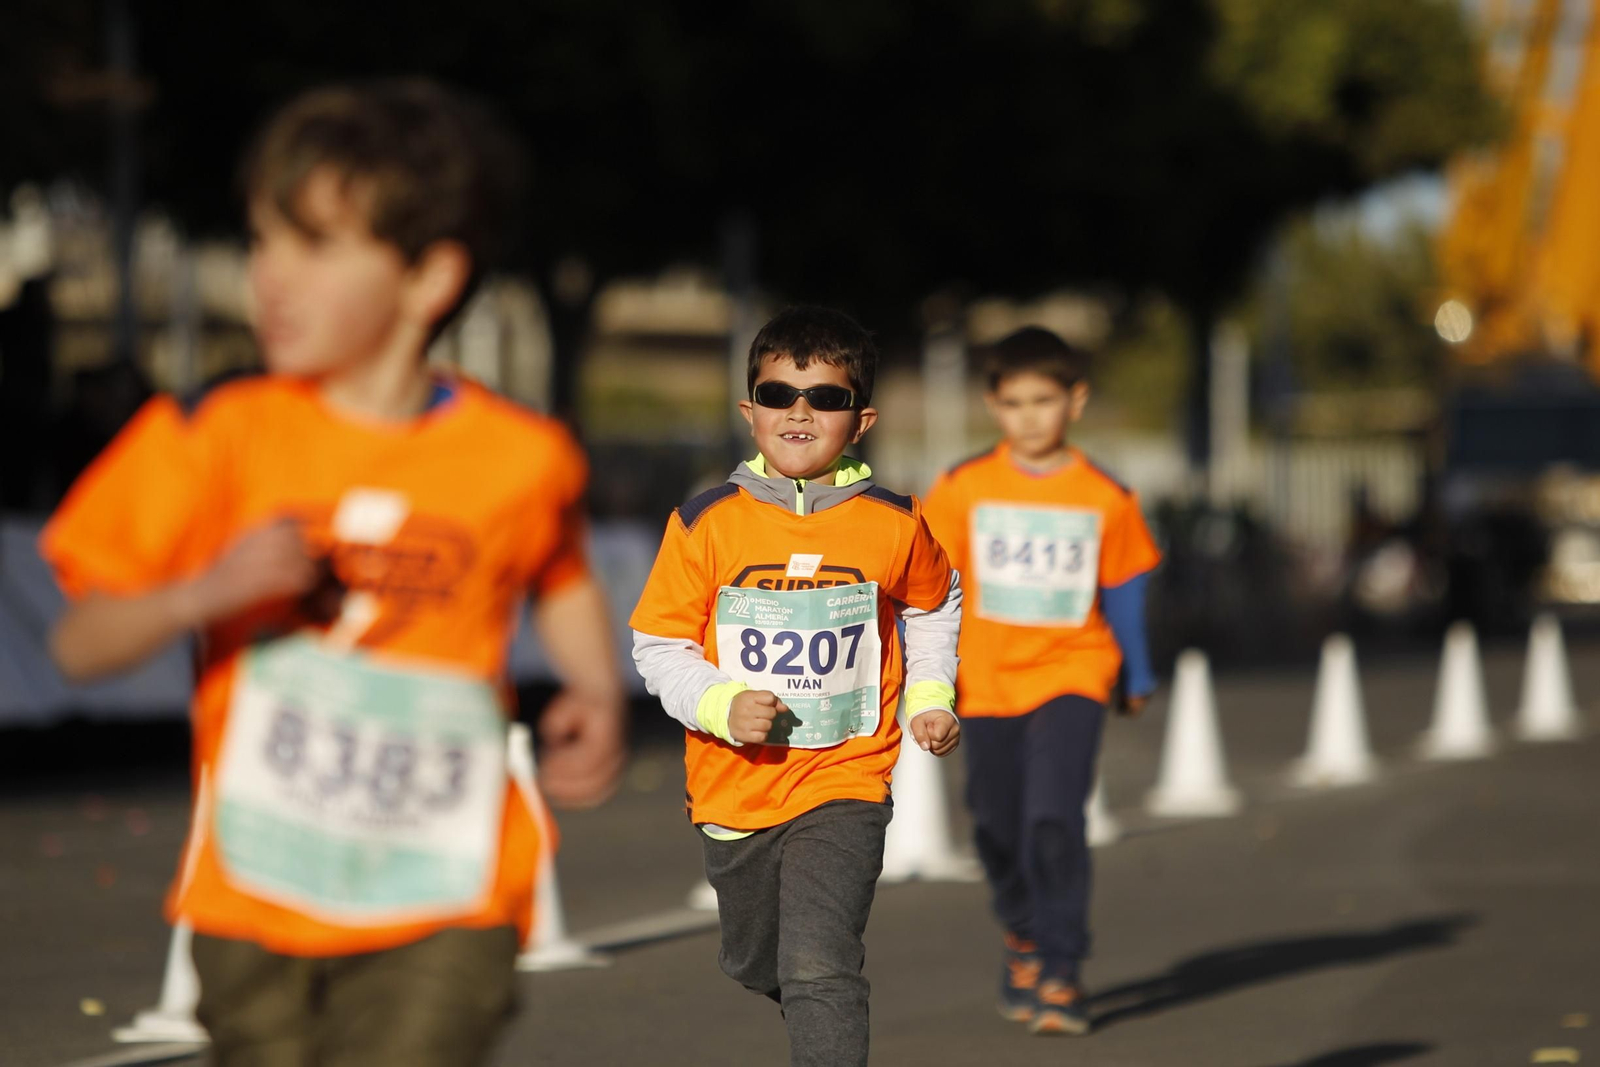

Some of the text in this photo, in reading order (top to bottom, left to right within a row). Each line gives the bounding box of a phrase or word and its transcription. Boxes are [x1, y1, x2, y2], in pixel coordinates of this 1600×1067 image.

[988, 536, 1084, 573] 8413
[755, 598, 779, 607] MEDIO
[826, 593, 873, 608] CARRERA
[754, 605, 793, 615] MARATÓN
[754, 613, 789, 621] ALMERÍA
[829, 604, 872, 620] INFANTIL
[740, 623, 865, 676] 8207
[787, 677, 822, 690] IVÁN
[264, 704, 470, 812] 8383
